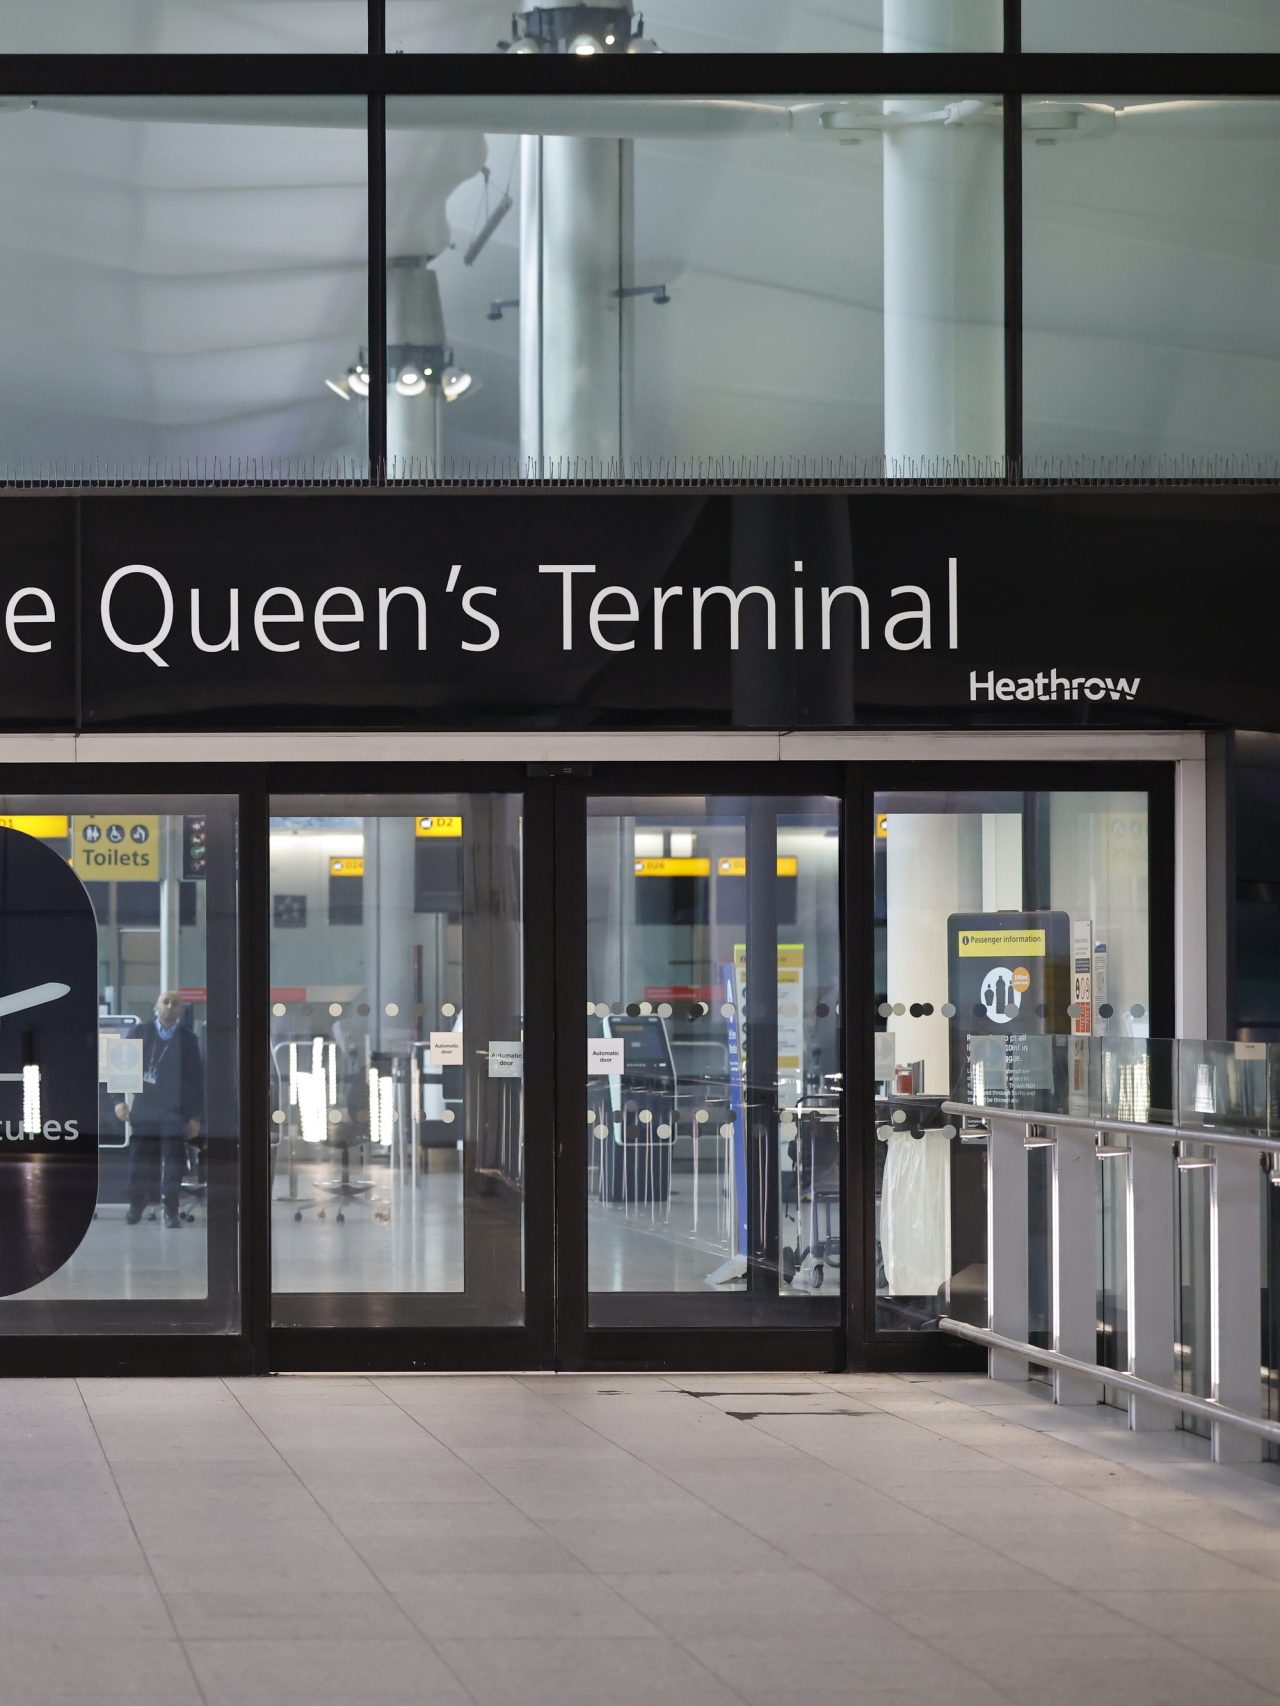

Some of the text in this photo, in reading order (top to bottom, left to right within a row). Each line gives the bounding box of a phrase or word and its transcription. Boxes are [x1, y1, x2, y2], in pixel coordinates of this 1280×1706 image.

[100, 564, 500, 667] Queen's
[538, 557, 958, 651] Terminal
[969, 667, 1141, 701] Heathrow
[82, 849, 150, 867] Toilets
[970, 935, 1042, 945] Passenger information
